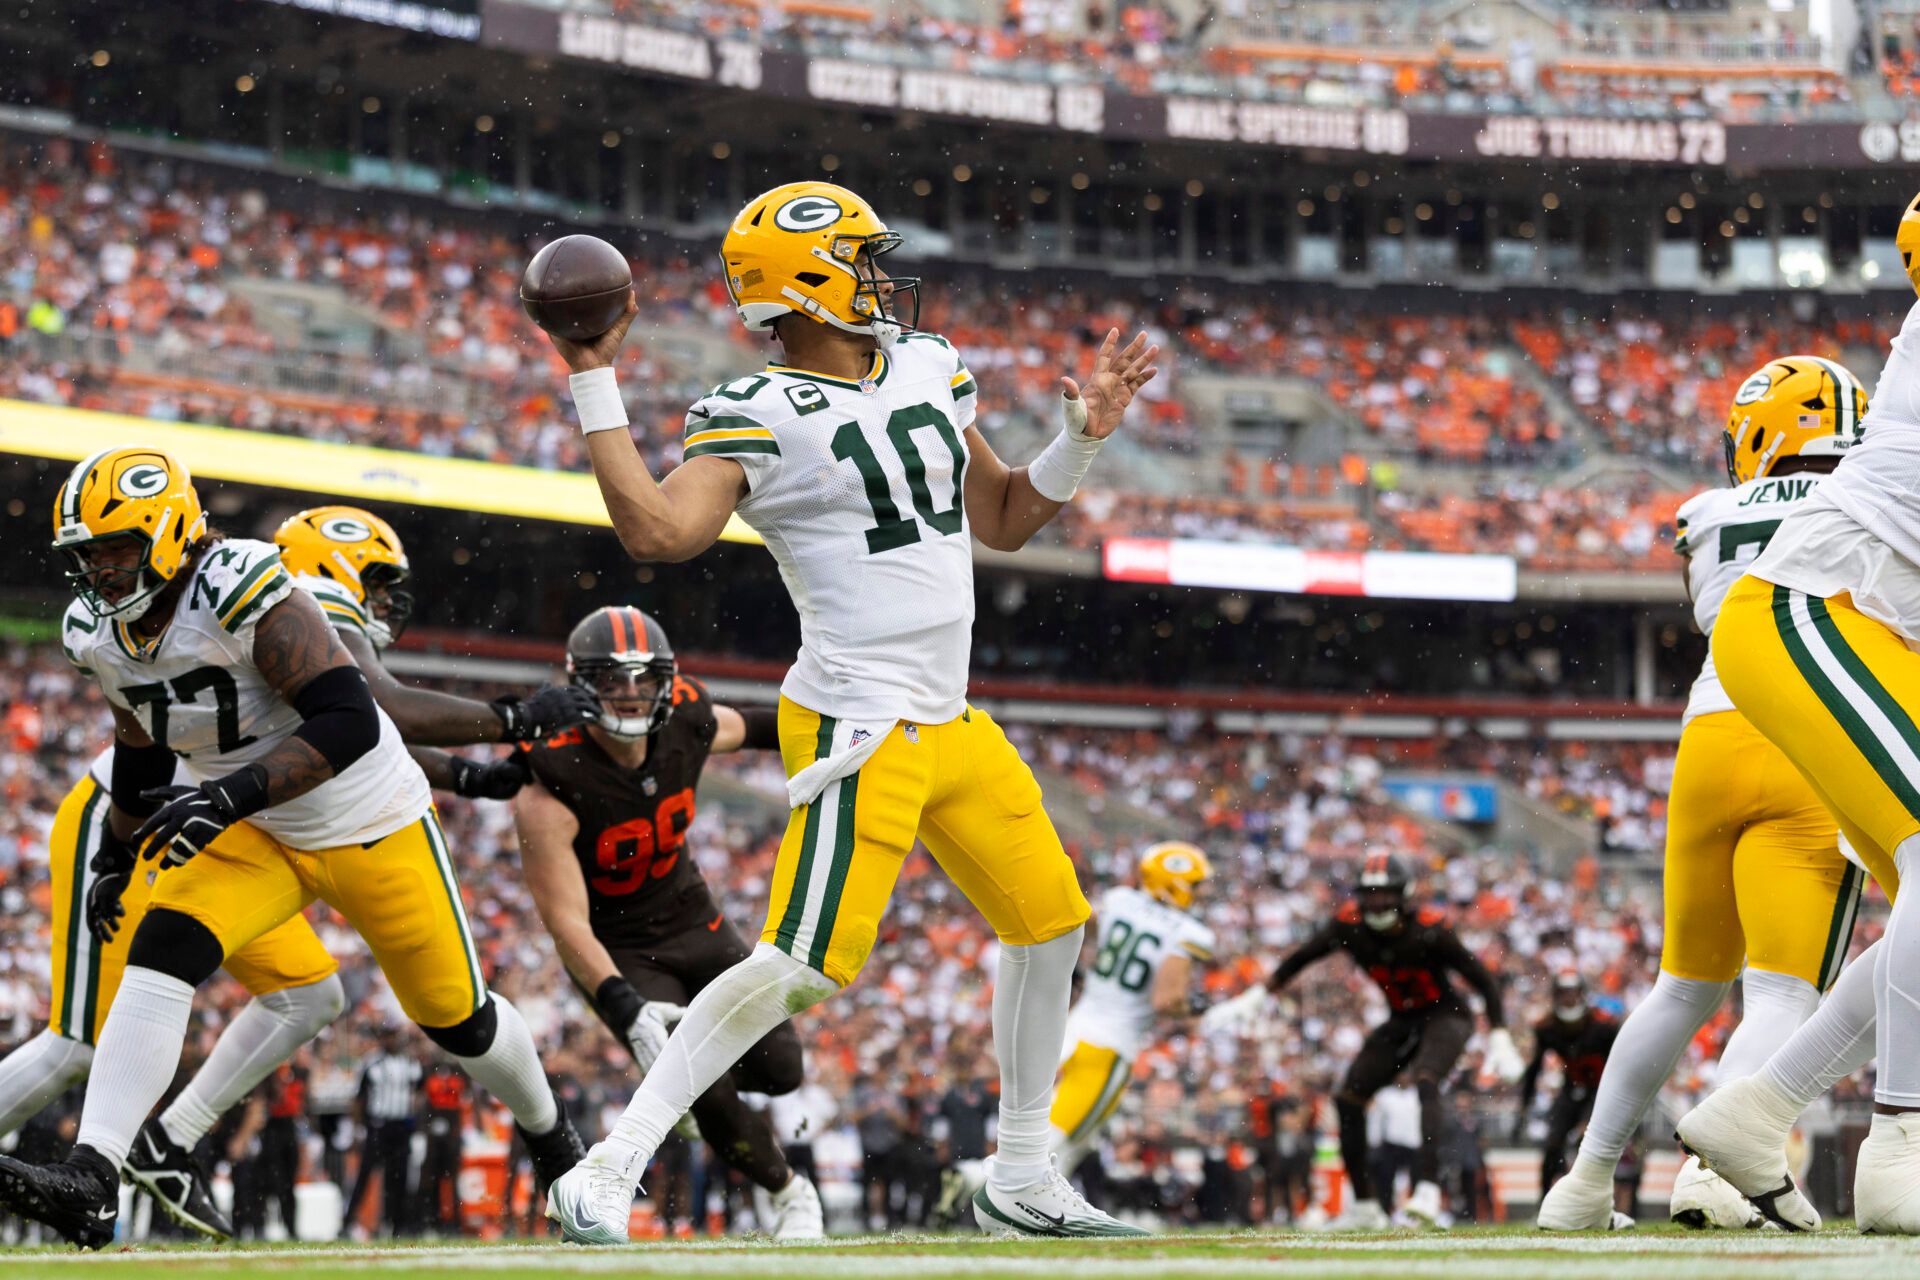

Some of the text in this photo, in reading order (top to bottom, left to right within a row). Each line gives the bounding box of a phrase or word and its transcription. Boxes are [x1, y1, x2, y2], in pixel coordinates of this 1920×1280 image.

[1474, 115, 1727, 166] JOE THOMAS 73
[788, 384, 822, 407] C
[118, 464, 169, 499] G
[830, 401, 967, 555] 10
[118, 665, 259, 759] 77
[591, 786, 697, 897] 99
[1097, 919, 1161, 992] 86
